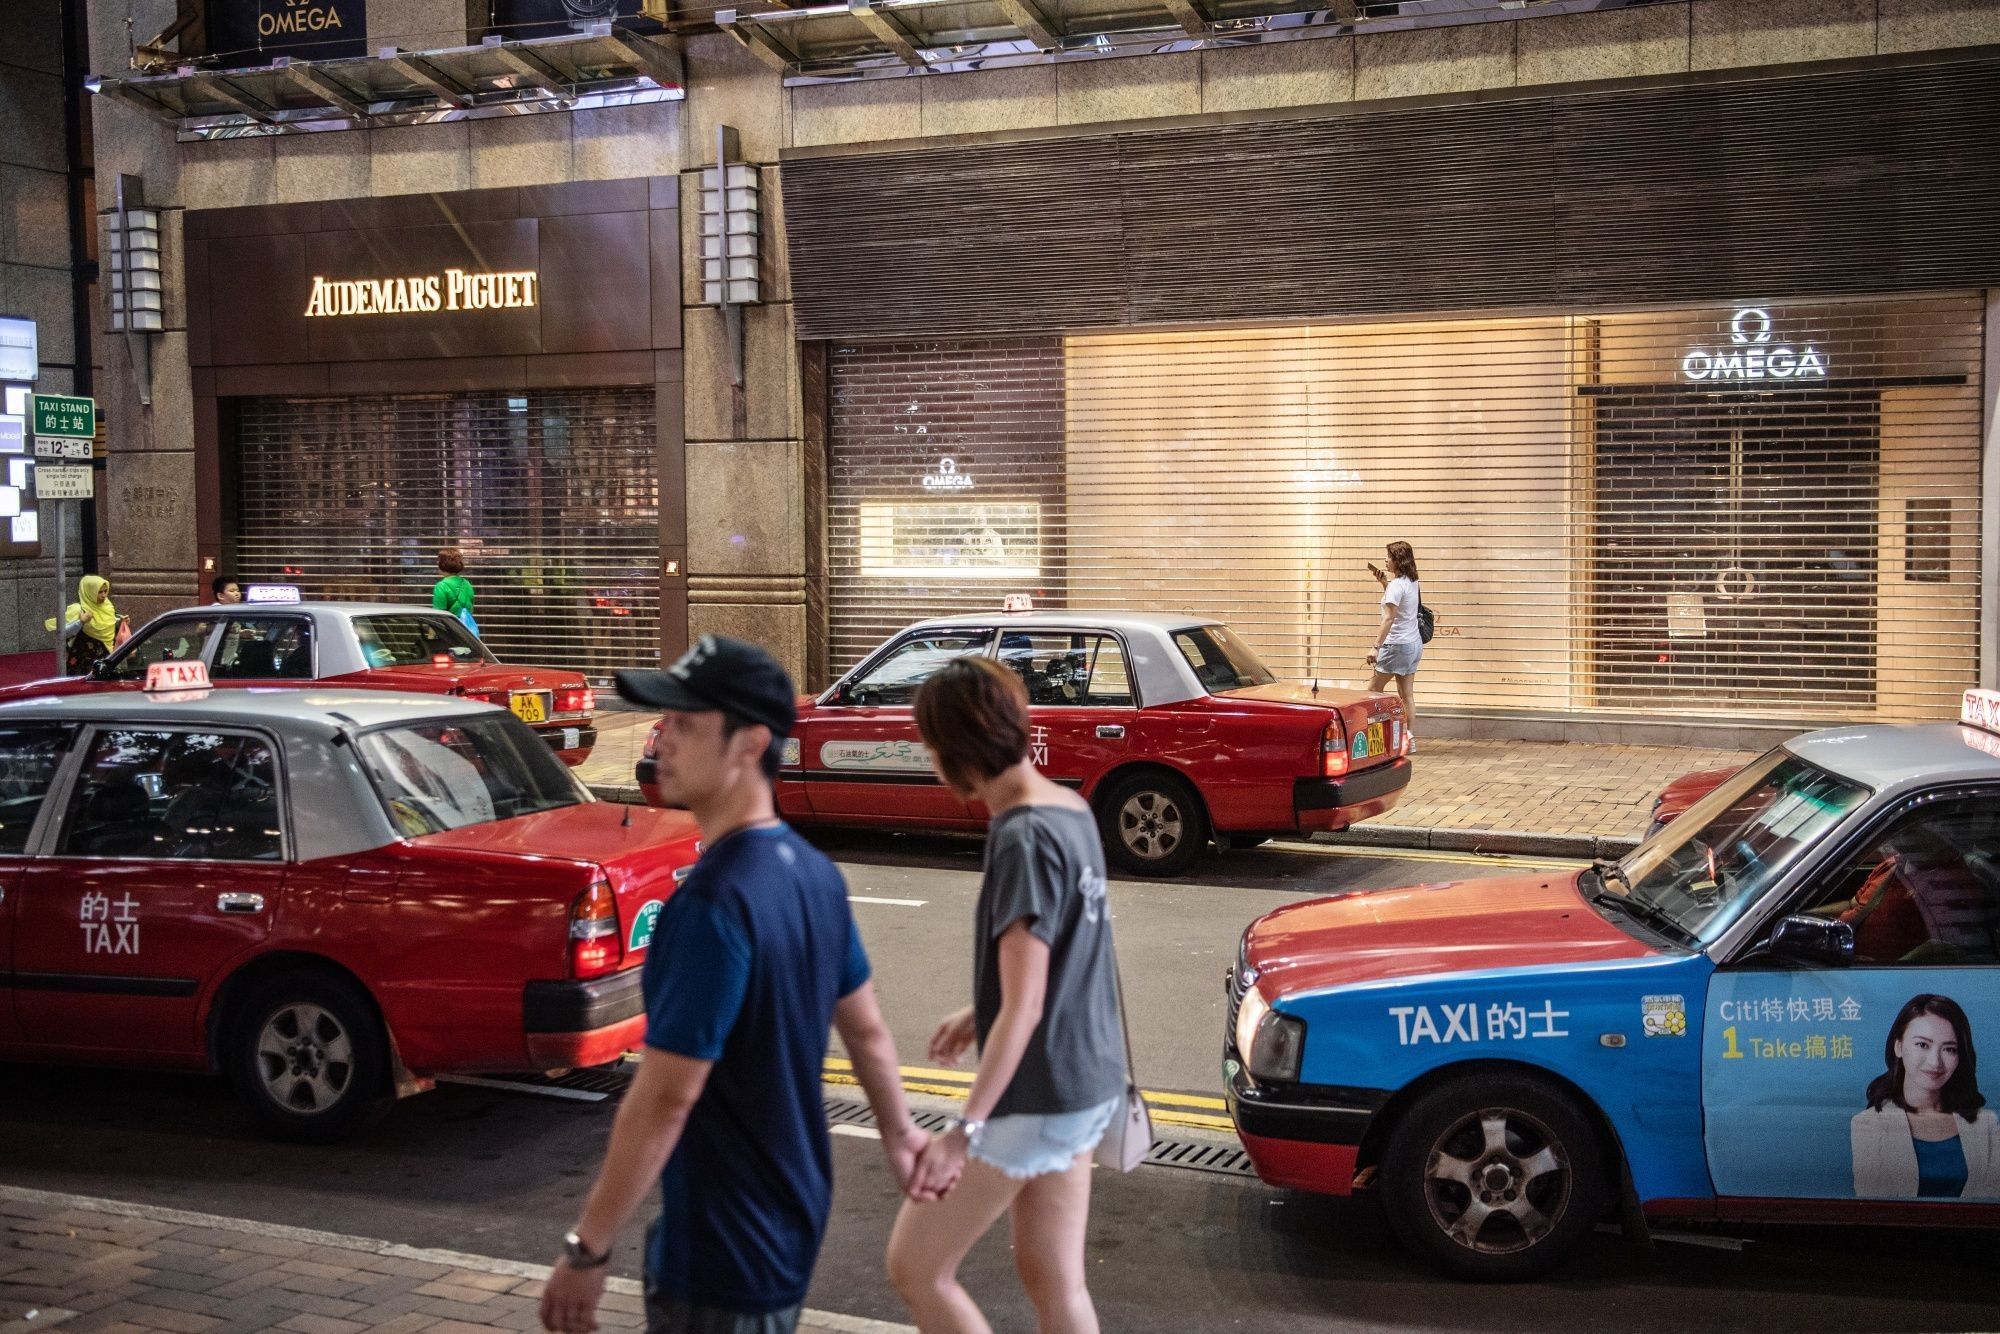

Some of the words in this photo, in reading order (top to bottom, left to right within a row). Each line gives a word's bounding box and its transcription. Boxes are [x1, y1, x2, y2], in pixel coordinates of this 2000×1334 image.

[258, 6, 342, 36] OMEGA
[304, 276, 441, 317] AUDEMARS
[445, 269, 537, 311] PIGUET
[1683, 347, 1826, 380] OMEGA
[39, 402, 58, 412] TAXI
[61, 403, 90, 414] STAND
[45, 415, 84, 431] 的士站
[51, 441, 62, 454] 12
[83, 443, 90, 456] 6
[923, 474, 975, 490] OMEGA
[1433, 627, 1461, 637] EGA
[166, 666, 206, 683] TAXI
[521, 696, 534, 709] AK
[1966, 694, 2000, 726] TAX
[518, 708, 540, 721] 709
[1030, 726, 1048, 747] 士
[1032, 746, 1048, 766] XI
[80, 891, 140, 922] 的士
[80, 922, 140, 954] TAXI
[1388, 1003, 1480, 1046] TAXI
[1486, 999, 1570, 1040] 的士
[1722, 1026, 1744, 1060] 1
